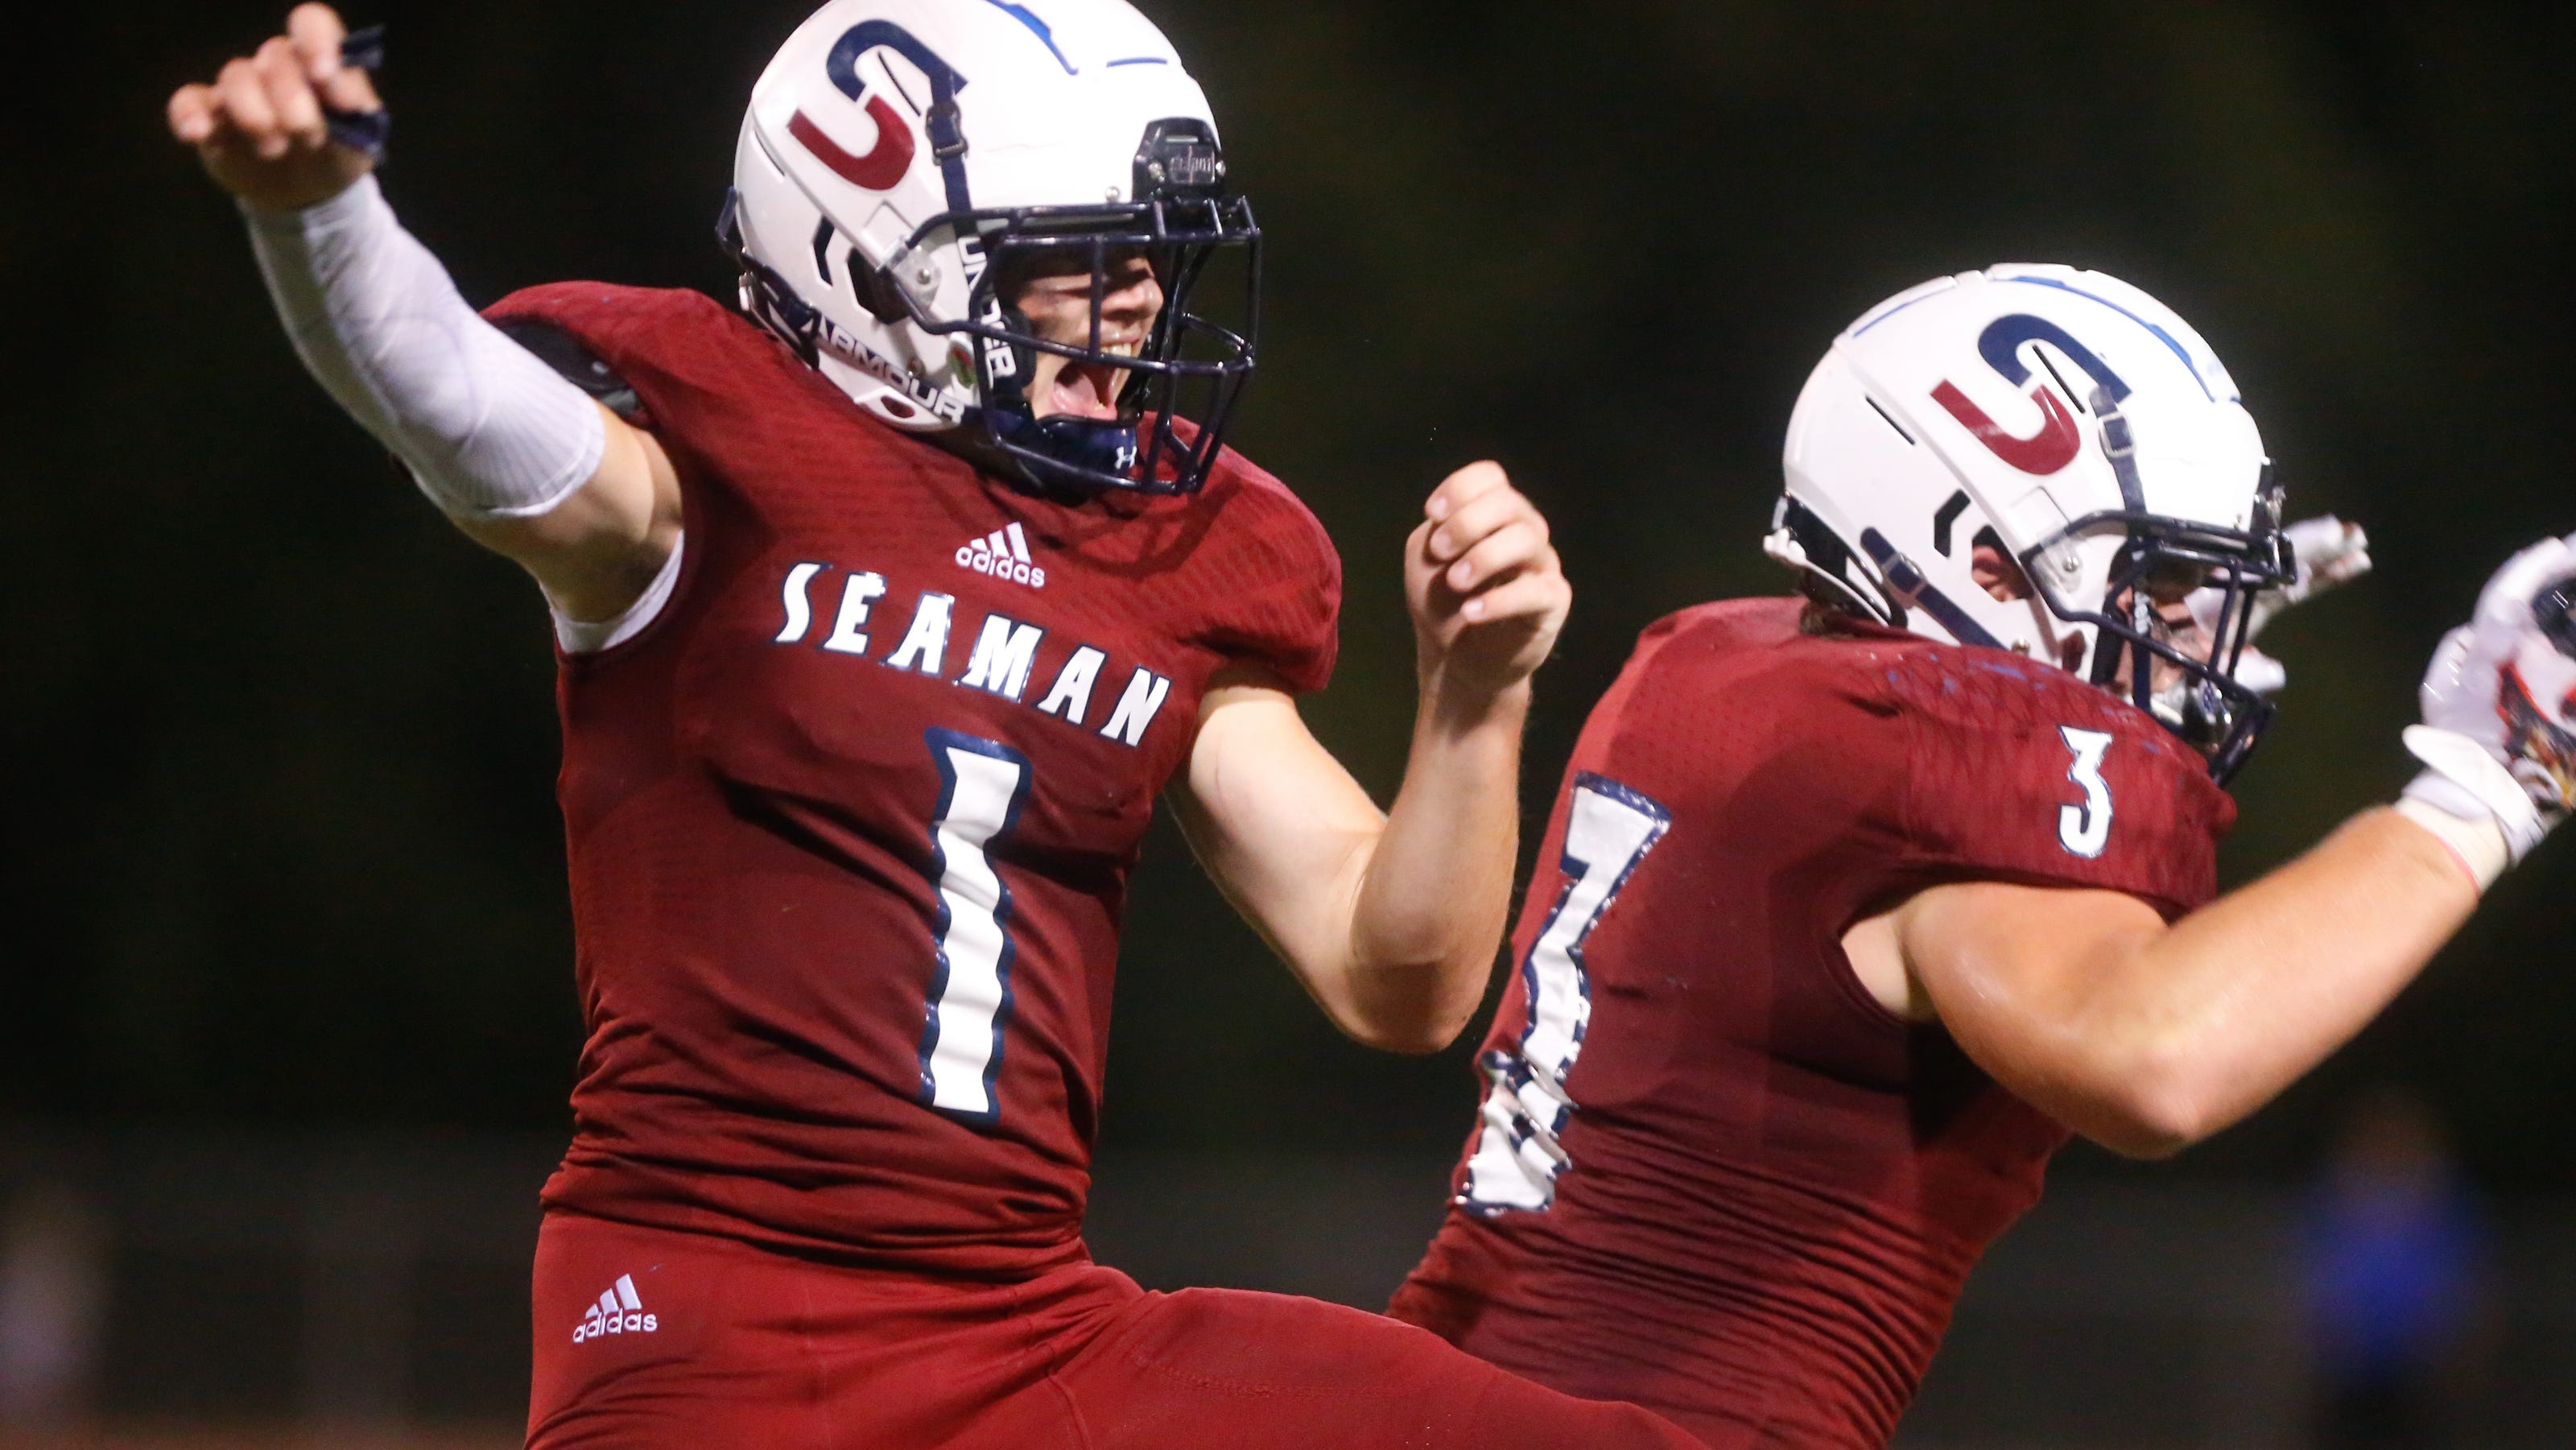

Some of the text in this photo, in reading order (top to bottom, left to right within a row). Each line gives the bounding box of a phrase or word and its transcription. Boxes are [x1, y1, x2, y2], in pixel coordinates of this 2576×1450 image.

[955, 546, 1046, 589] adidas
[774, 561, 1172, 748] SEAMAN
[2056, 724, 2114, 858] 3
[918, 726, 1033, 1124] 1
[572, 1307, 658, 1344] adidas
